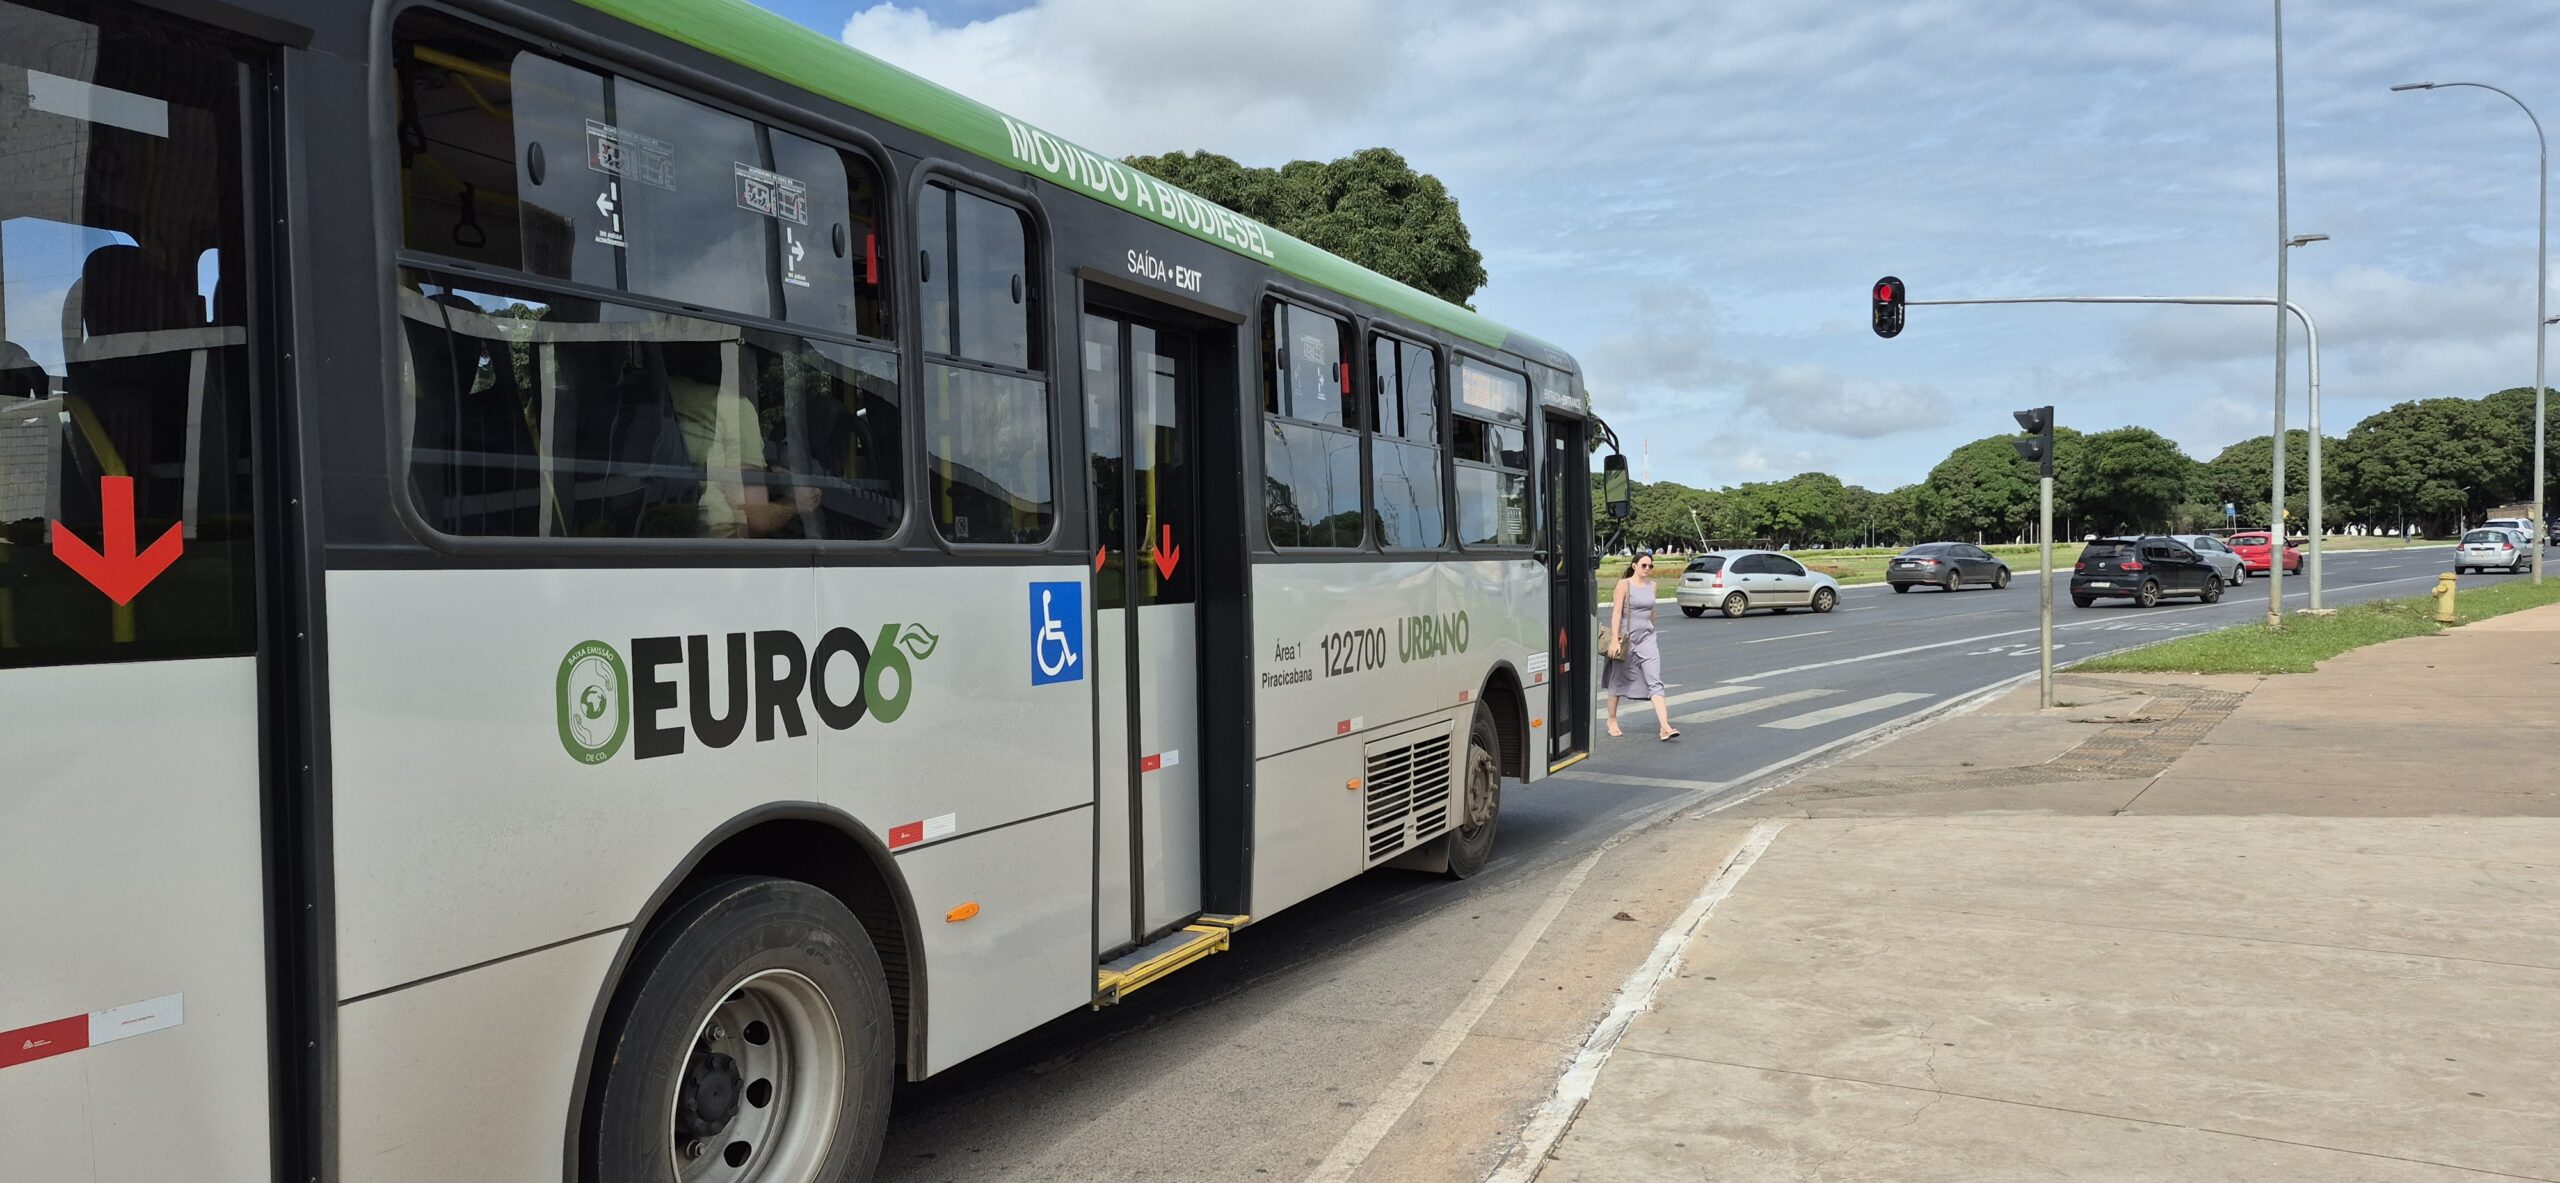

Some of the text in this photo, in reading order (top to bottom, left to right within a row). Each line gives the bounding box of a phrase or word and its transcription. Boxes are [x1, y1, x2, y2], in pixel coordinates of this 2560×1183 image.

[1002, 117, 1274, 258] MOVIDO A BIODIESEL
[1127, 249, 1202, 293] SAÍDA EXIT
[1275, 638, 1302, 662] Área 1
[1320, 627, 1386, 678] 122700
[1398, 610, 1469, 664] URBANO
[567, 646, 614, 666] BAIXA EMISSÃO
[1262, 667, 1313, 689] Piracicabana
[586, 753, 595, 762] DE
